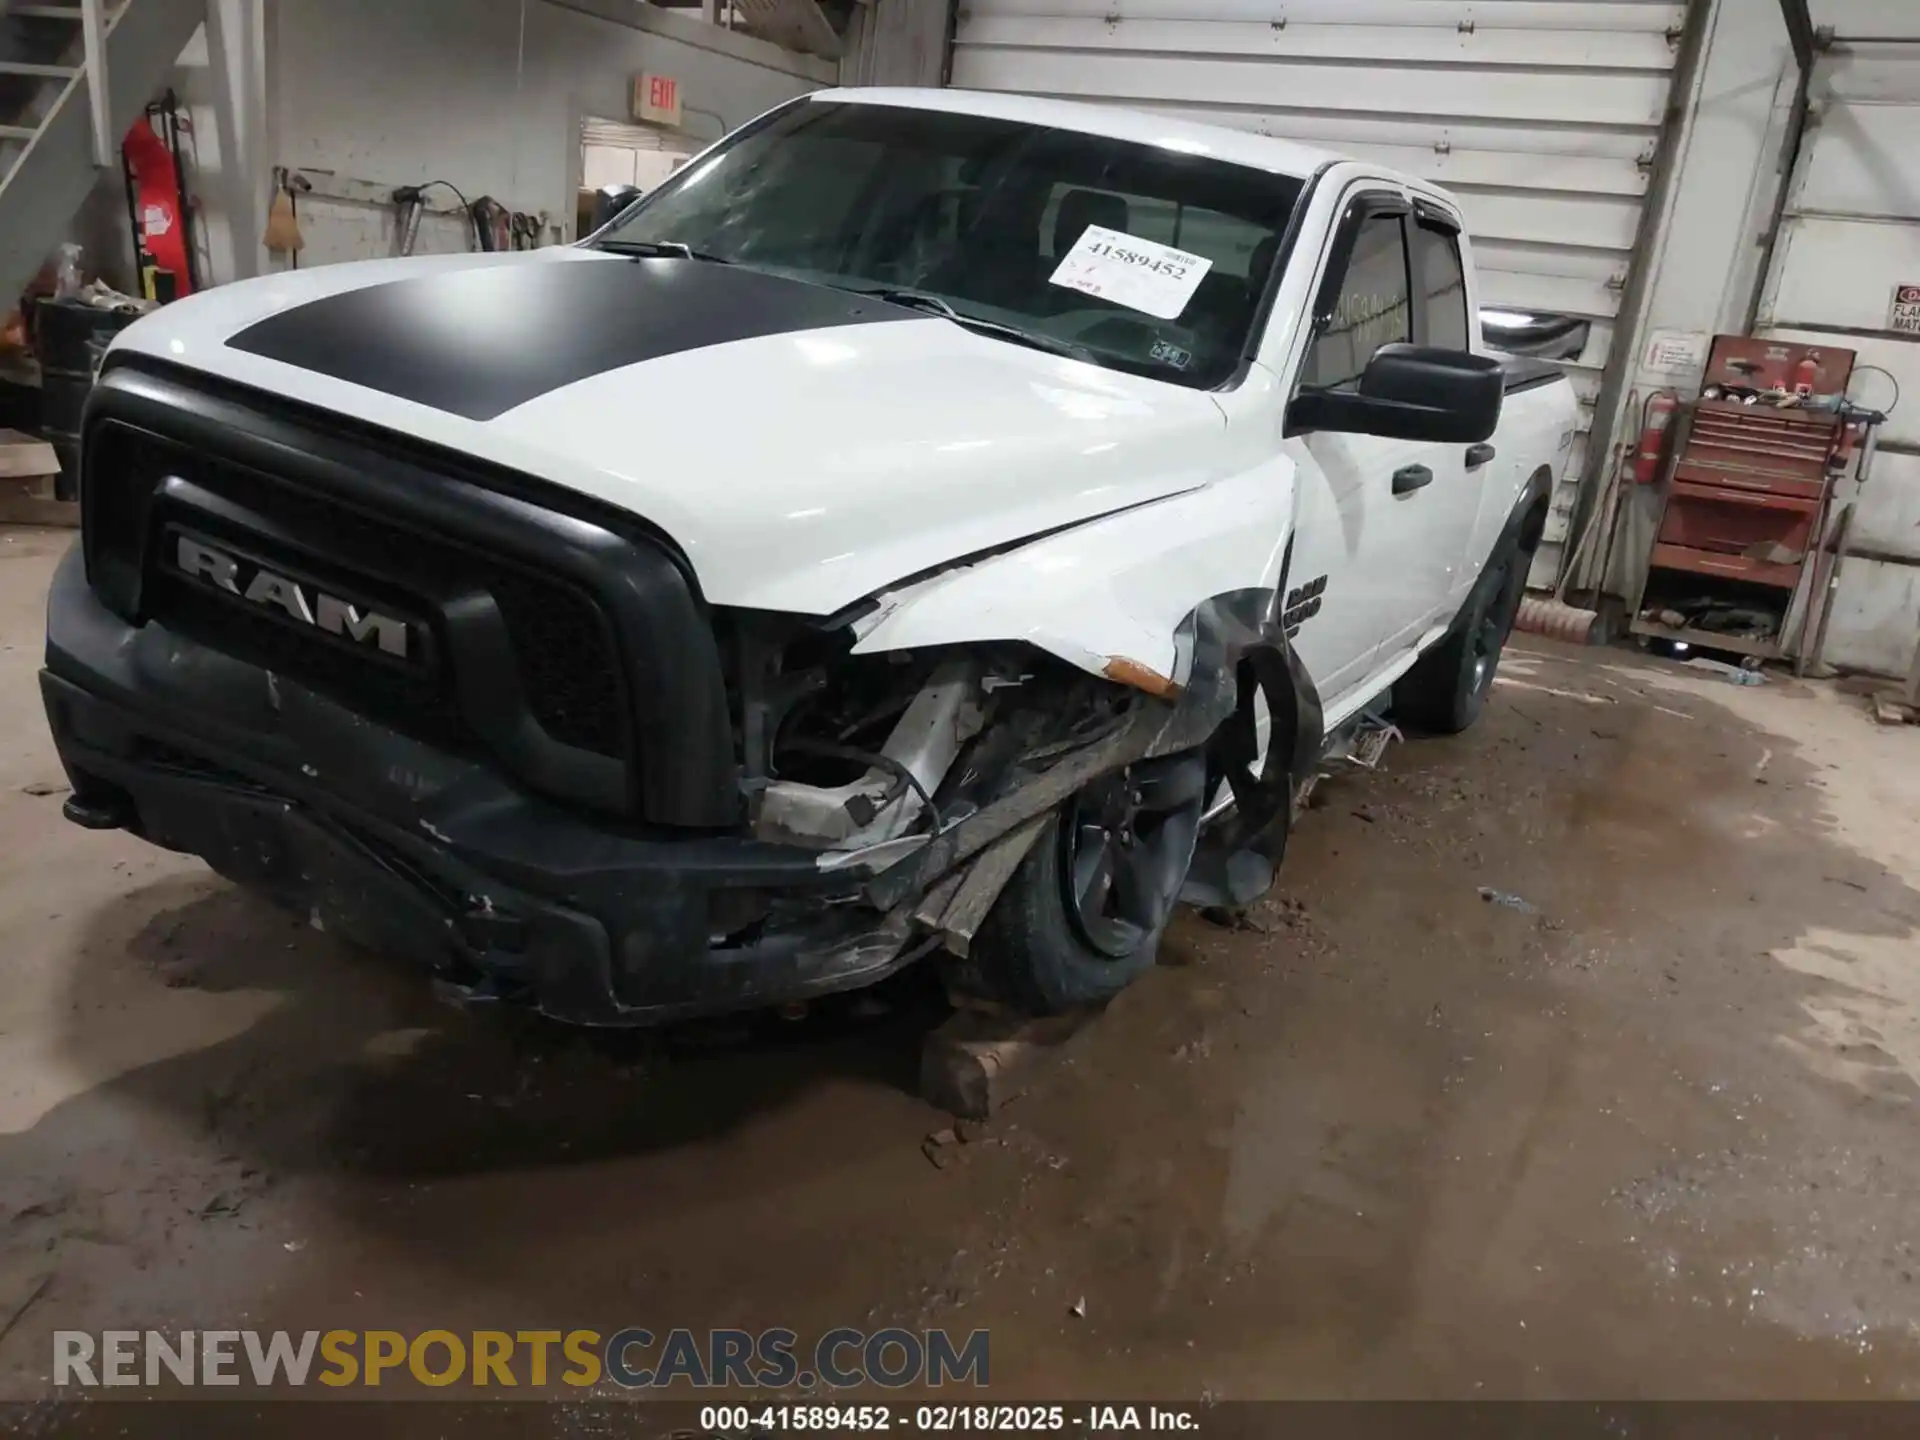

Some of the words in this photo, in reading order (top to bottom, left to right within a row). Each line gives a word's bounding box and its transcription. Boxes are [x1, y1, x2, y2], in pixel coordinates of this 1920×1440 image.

[650, 76, 677, 112] EXIT
[1087, 242, 1188, 281] 41589452
[177, 536, 407, 658] RAM
